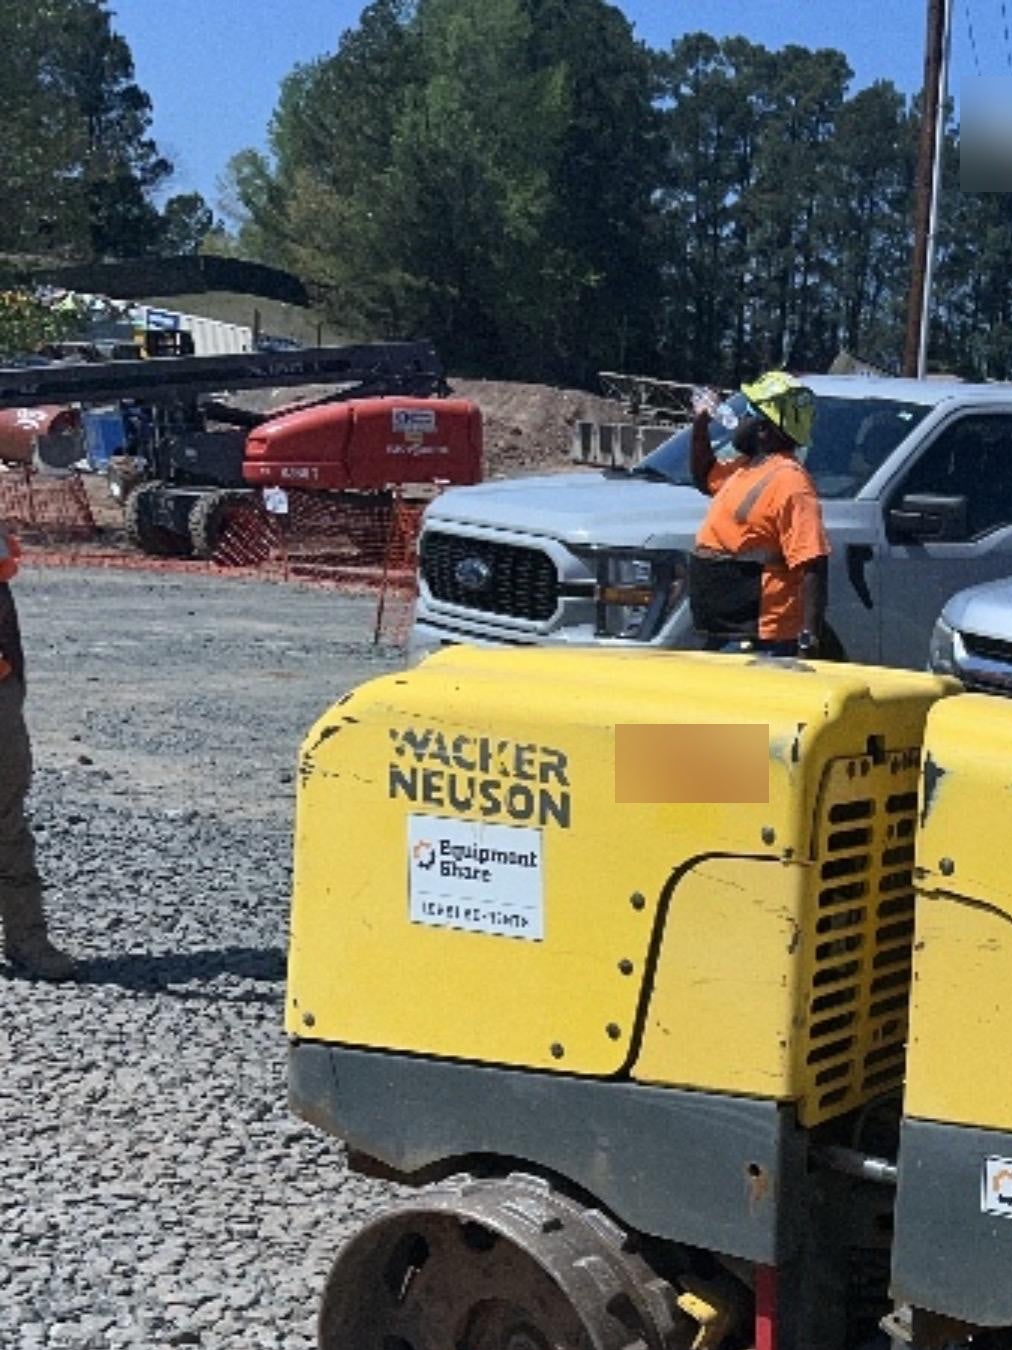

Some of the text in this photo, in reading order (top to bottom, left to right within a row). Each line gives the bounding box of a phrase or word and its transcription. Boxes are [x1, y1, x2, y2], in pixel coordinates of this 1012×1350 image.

[389, 727, 570, 788] WACKER
[388, 763, 571, 829] NEUSON
[439, 839, 538, 868] Equipment
[440, 860, 493, 883] Share
